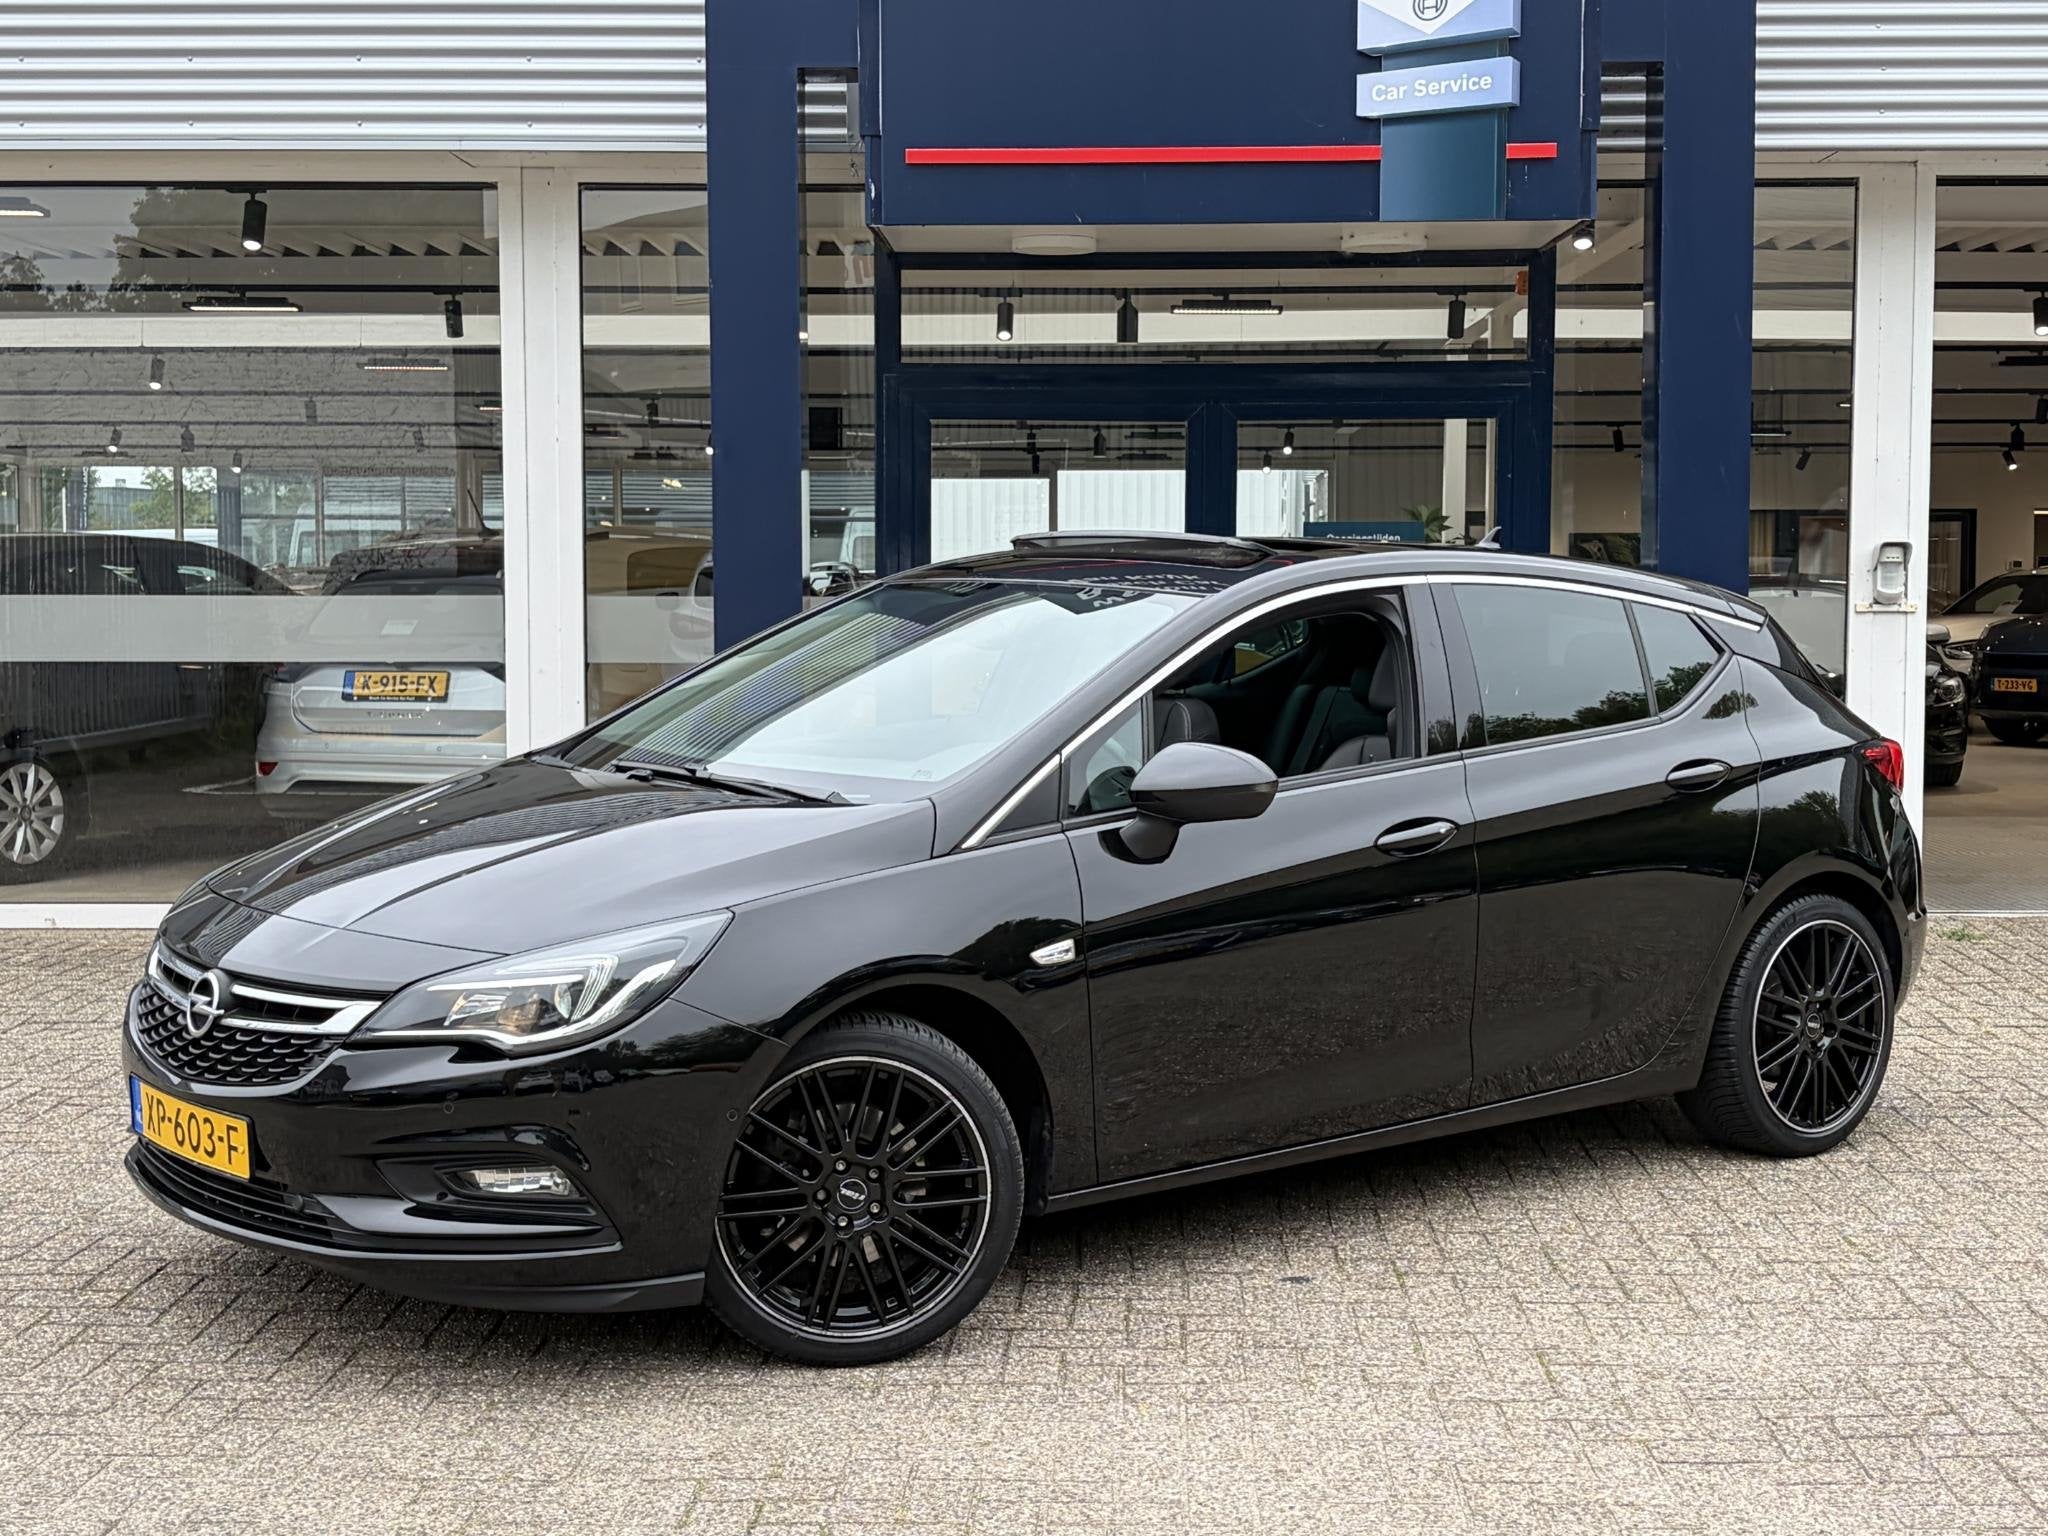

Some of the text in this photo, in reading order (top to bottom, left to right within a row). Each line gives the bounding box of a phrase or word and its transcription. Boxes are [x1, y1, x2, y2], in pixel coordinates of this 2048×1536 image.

[1371, 73, 1493, 101] Car Service
[145, 1091, 239, 1165] XP-603-F
